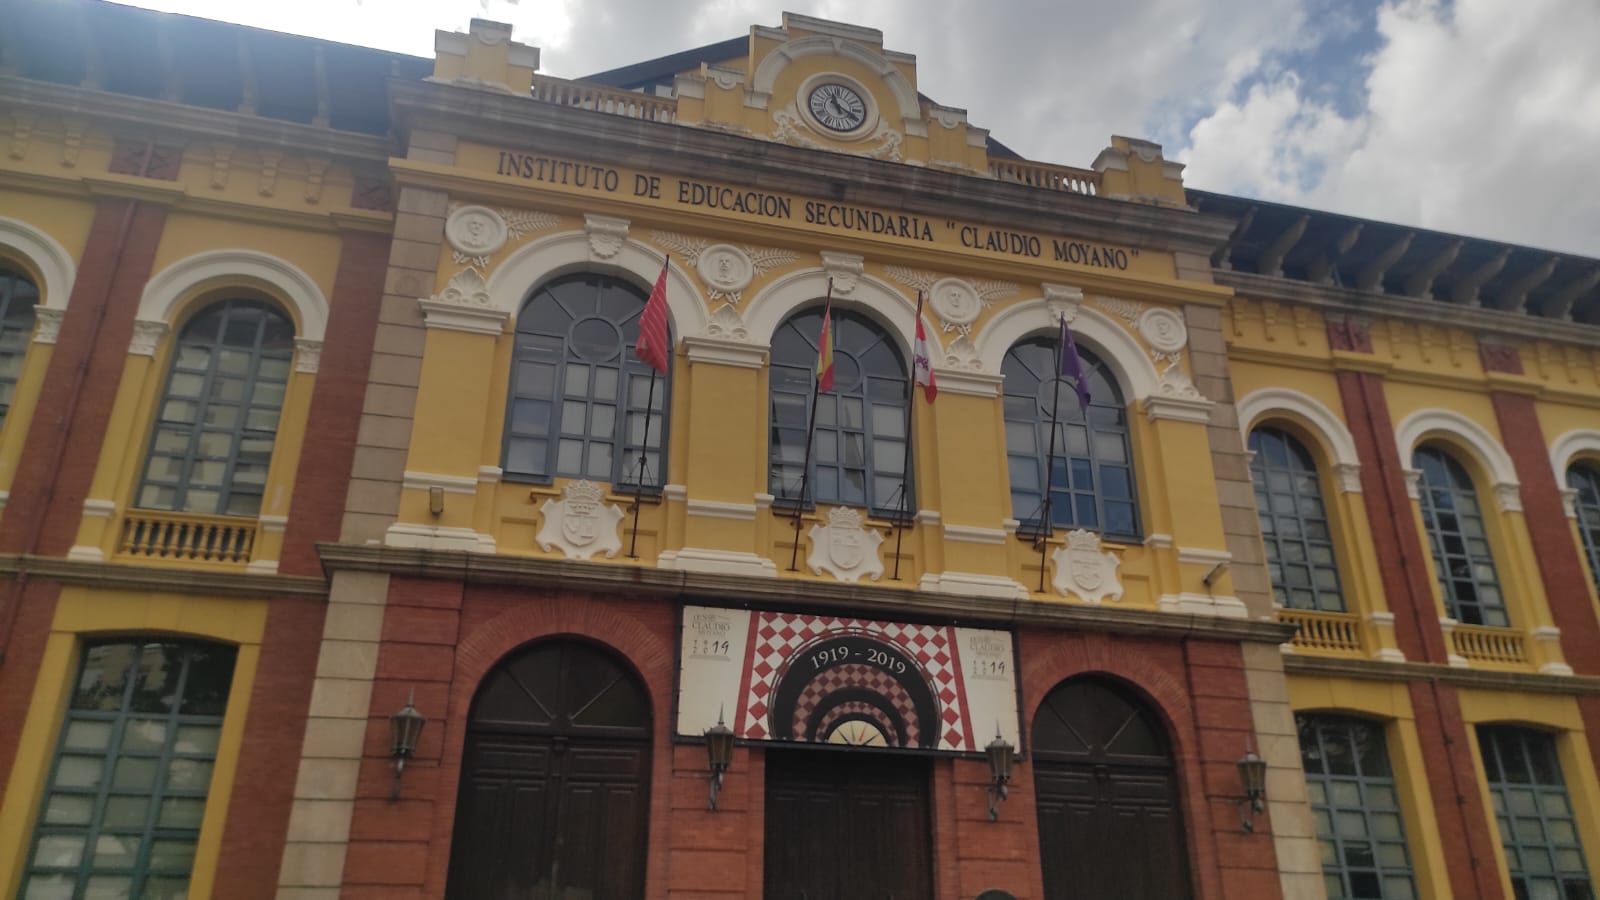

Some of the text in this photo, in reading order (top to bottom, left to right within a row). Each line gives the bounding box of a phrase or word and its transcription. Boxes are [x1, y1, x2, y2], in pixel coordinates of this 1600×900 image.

[498, 152, 619, 192] INSTITUTO
[634, 174, 661, 199] DE
[678, 180, 792, 219] EDUCACION
[805, 201, 934, 242] SECUNDARIA
[811, 646, 849, 670] 1919
[867, 648, 906, 674] 2019
